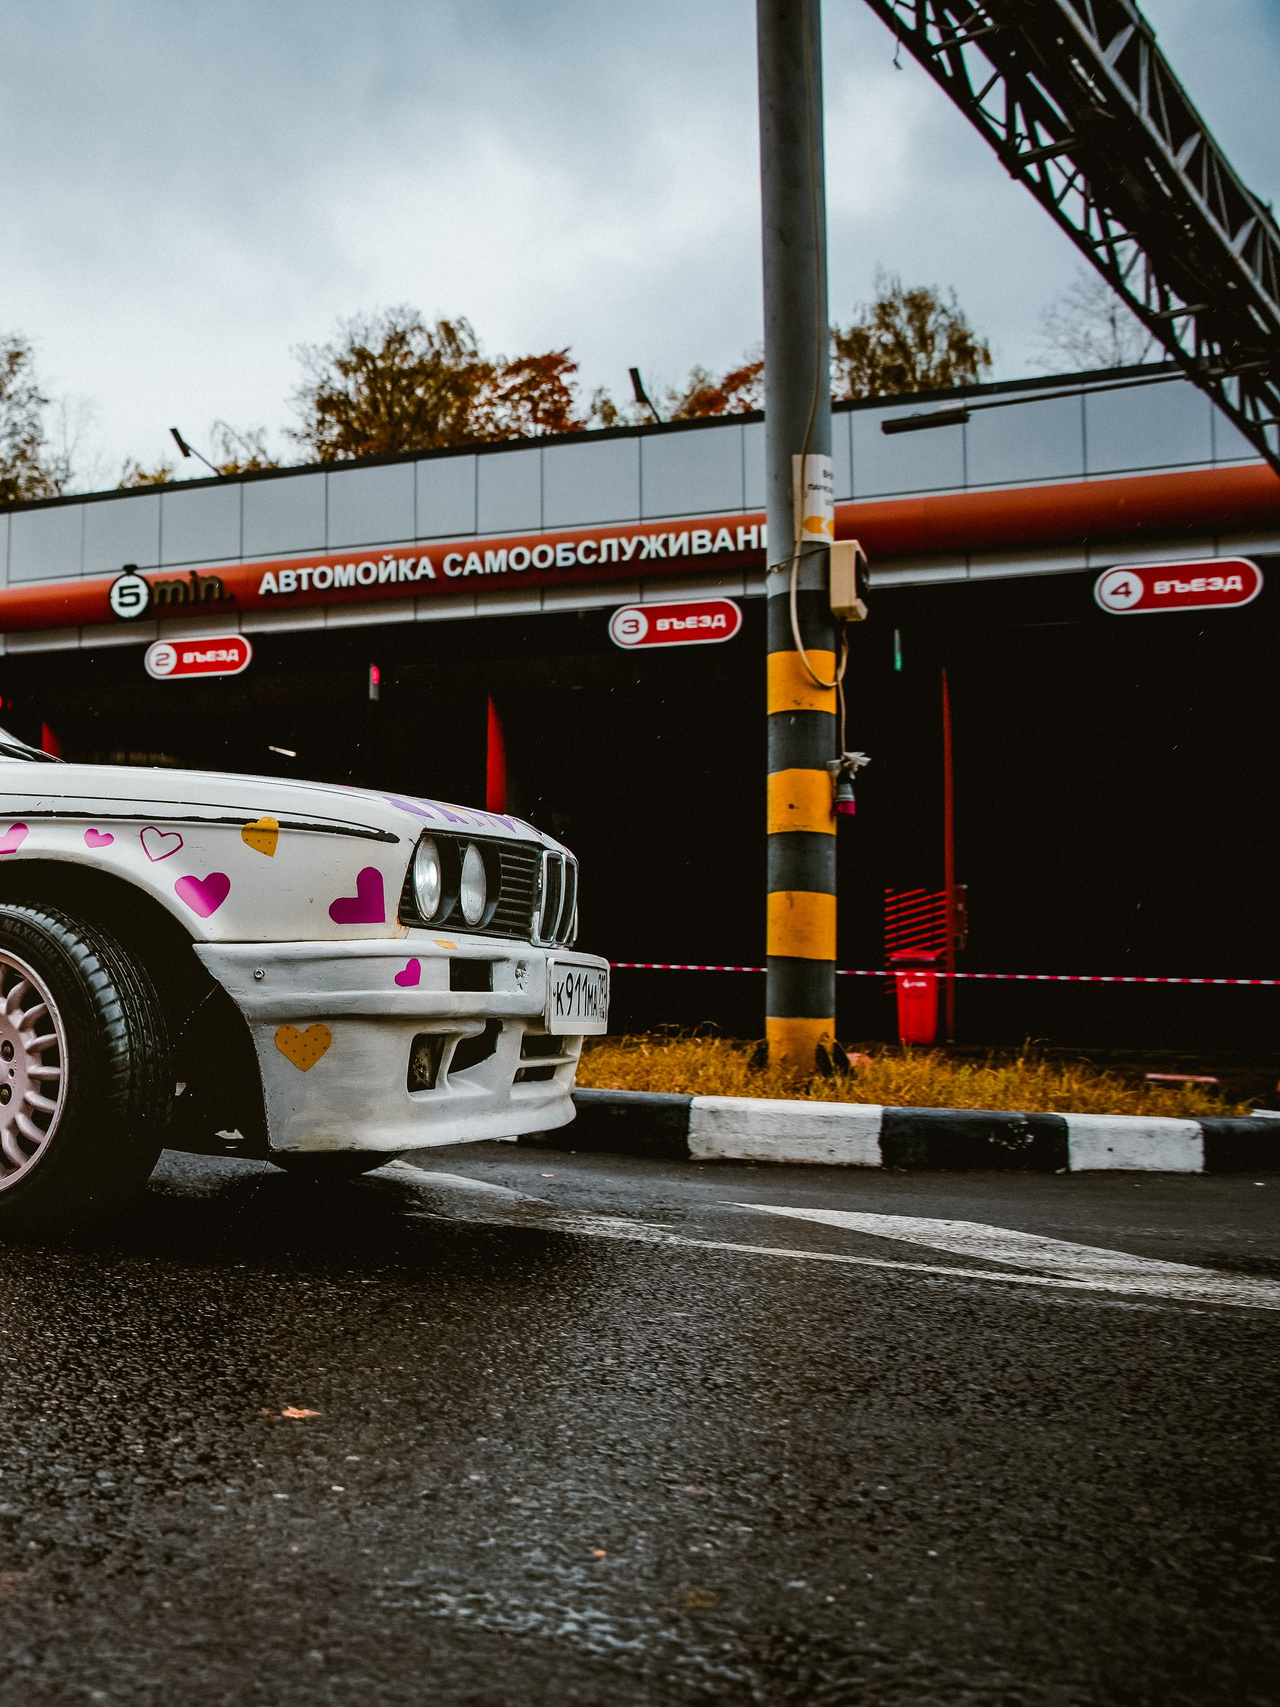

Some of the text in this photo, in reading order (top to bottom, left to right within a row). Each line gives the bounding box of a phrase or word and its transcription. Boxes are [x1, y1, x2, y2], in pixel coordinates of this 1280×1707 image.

[258, 555, 436, 594] АВТОМОЙКА
[116, 584, 141, 608] 5
[1110, 576, 1243, 598] 4 ВЪЕЗД
[620, 613, 726, 635] 3 ВЪЕЗД
[155, 648, 239, 666] 2 ВЪЕЗД
[2, 918, 58, 962] MAXIMUM
